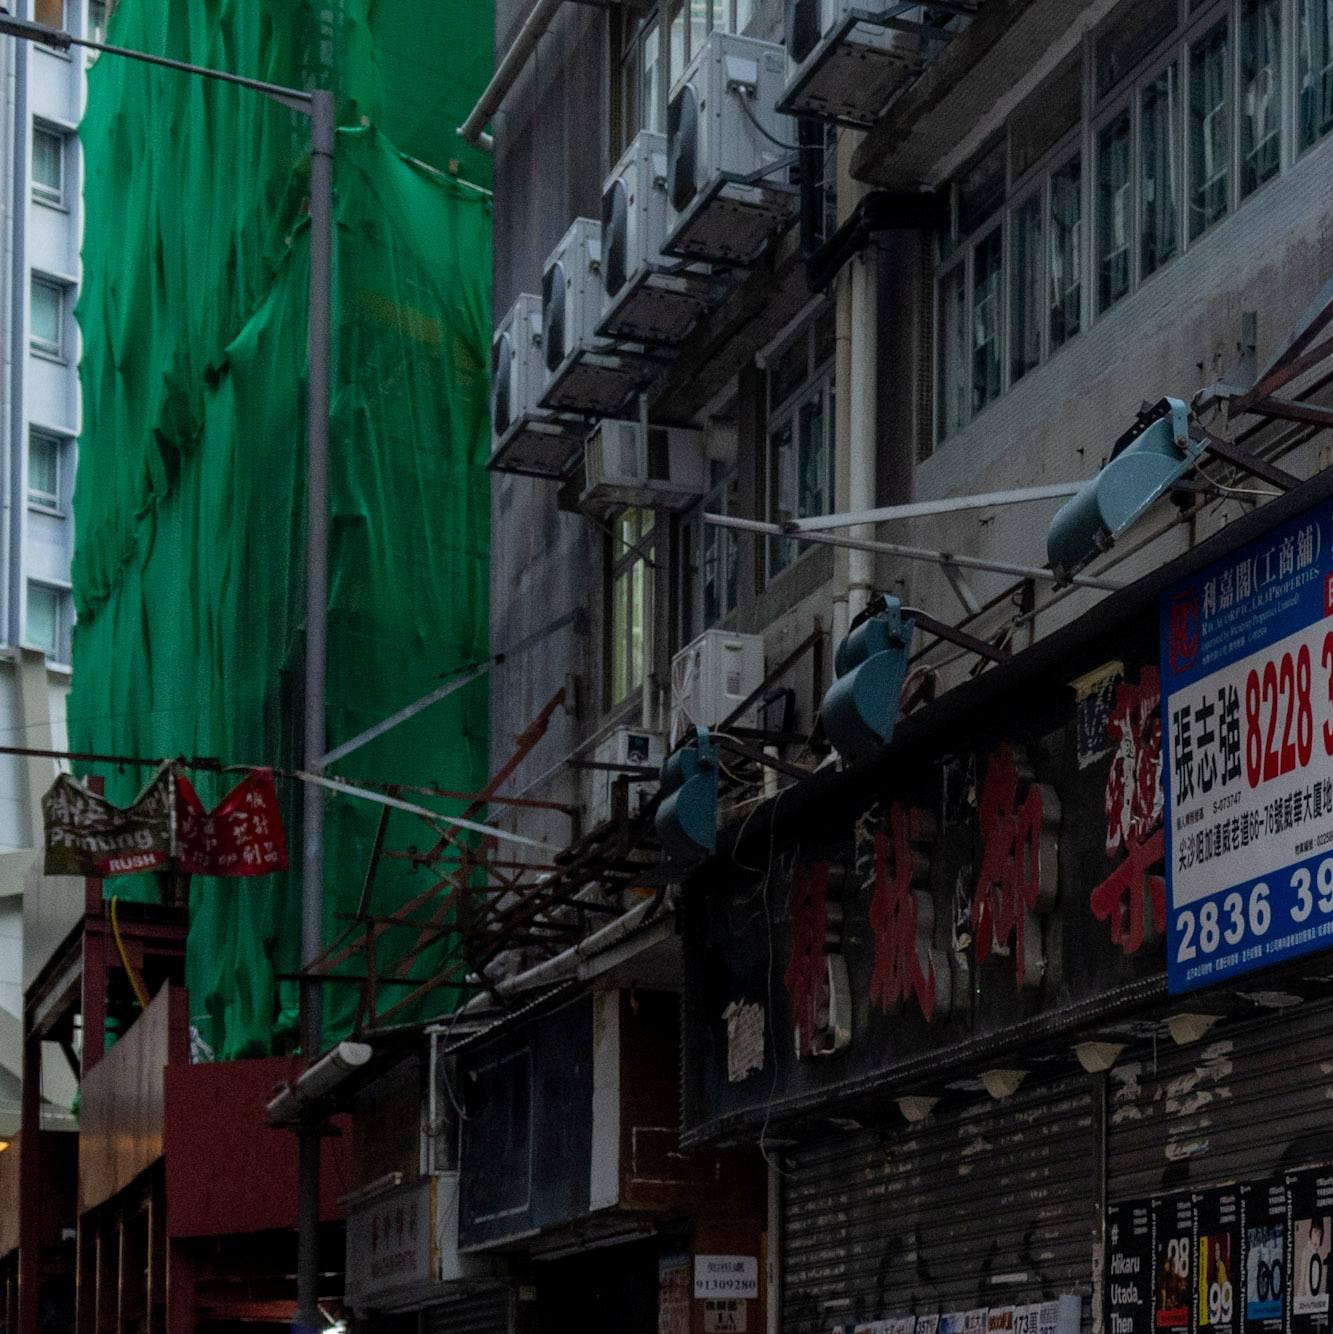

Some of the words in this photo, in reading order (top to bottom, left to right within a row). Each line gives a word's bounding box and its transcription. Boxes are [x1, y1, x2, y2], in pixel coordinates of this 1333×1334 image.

[1173, 683, 1242, 806] 張志強
[1246, 643, 1313, 789] 8228
[109, 852, 157, 872] RUSH
[1176, 882, 1272, 964] 2836
[1110, 1253, 1141, 1276] Hikaru
[1208, 1280, 1233, 1324] 99
[1110, 1312, 1134, 1334] Then
